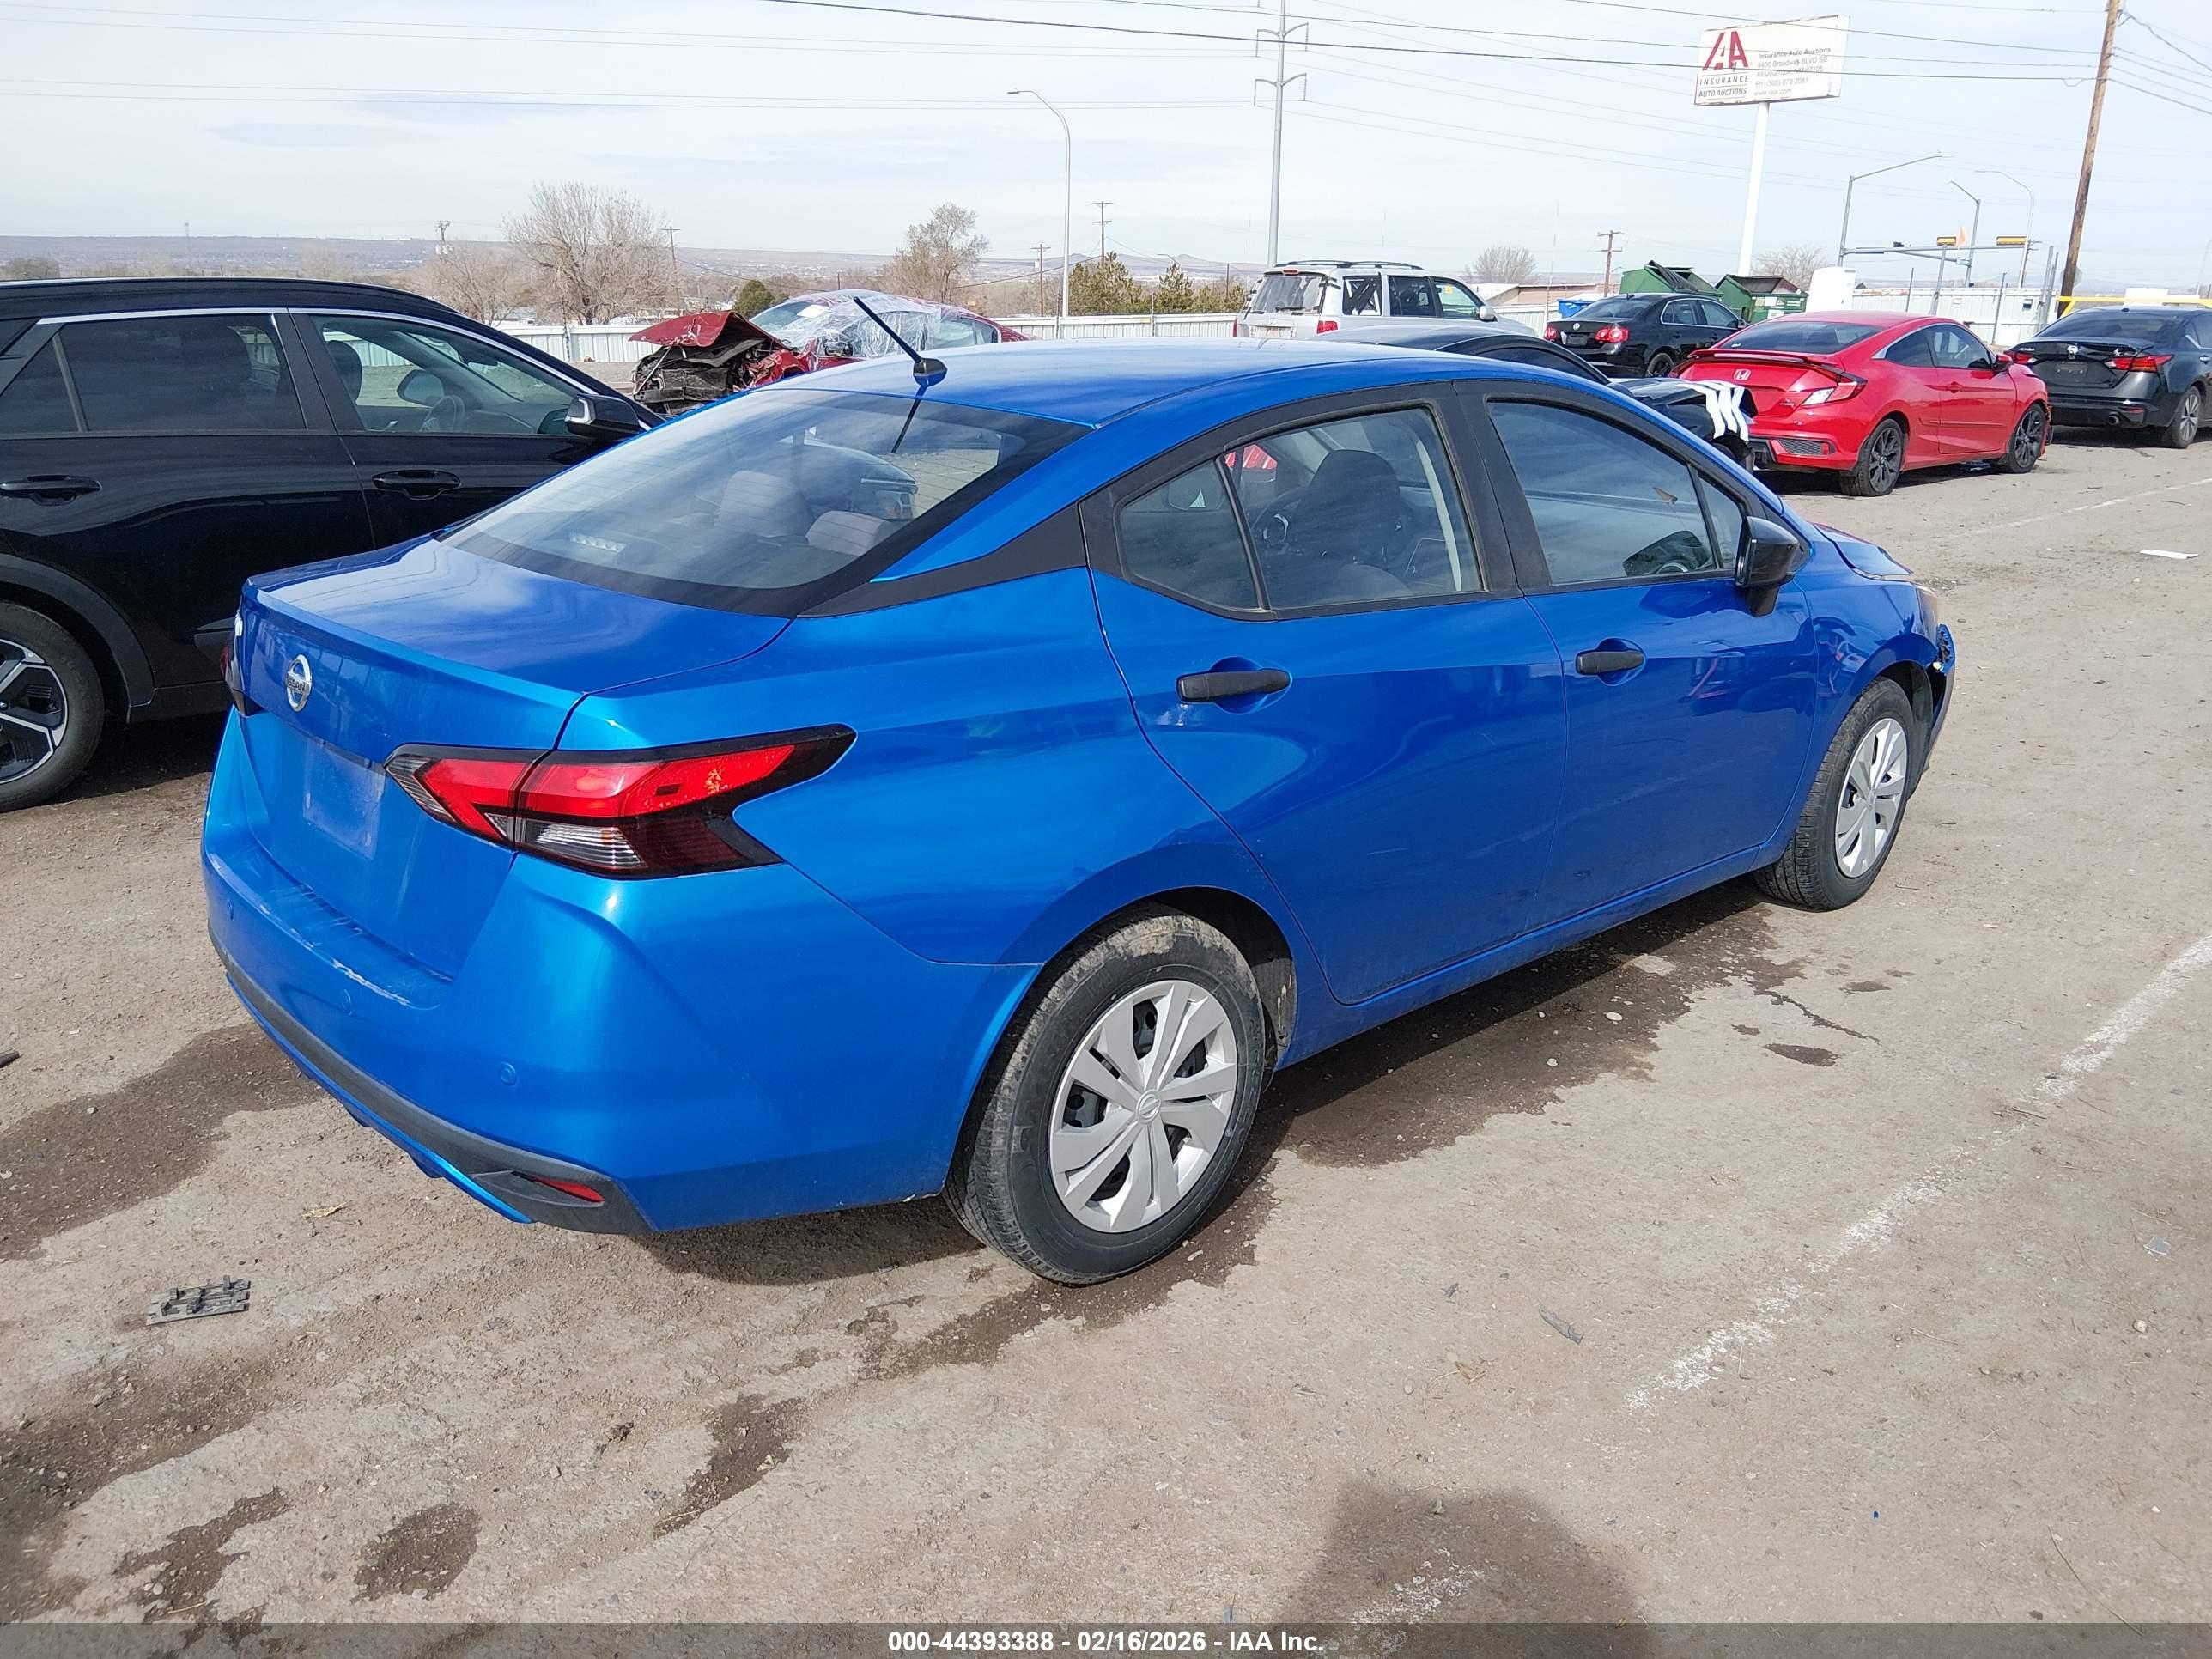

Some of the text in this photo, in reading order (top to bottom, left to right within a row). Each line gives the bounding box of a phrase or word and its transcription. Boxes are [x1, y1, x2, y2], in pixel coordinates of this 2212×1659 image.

[1699, 75, 1749, 86] INSURANCE
[1698, 87, 1747, 97] AUTO AUCTIONS
